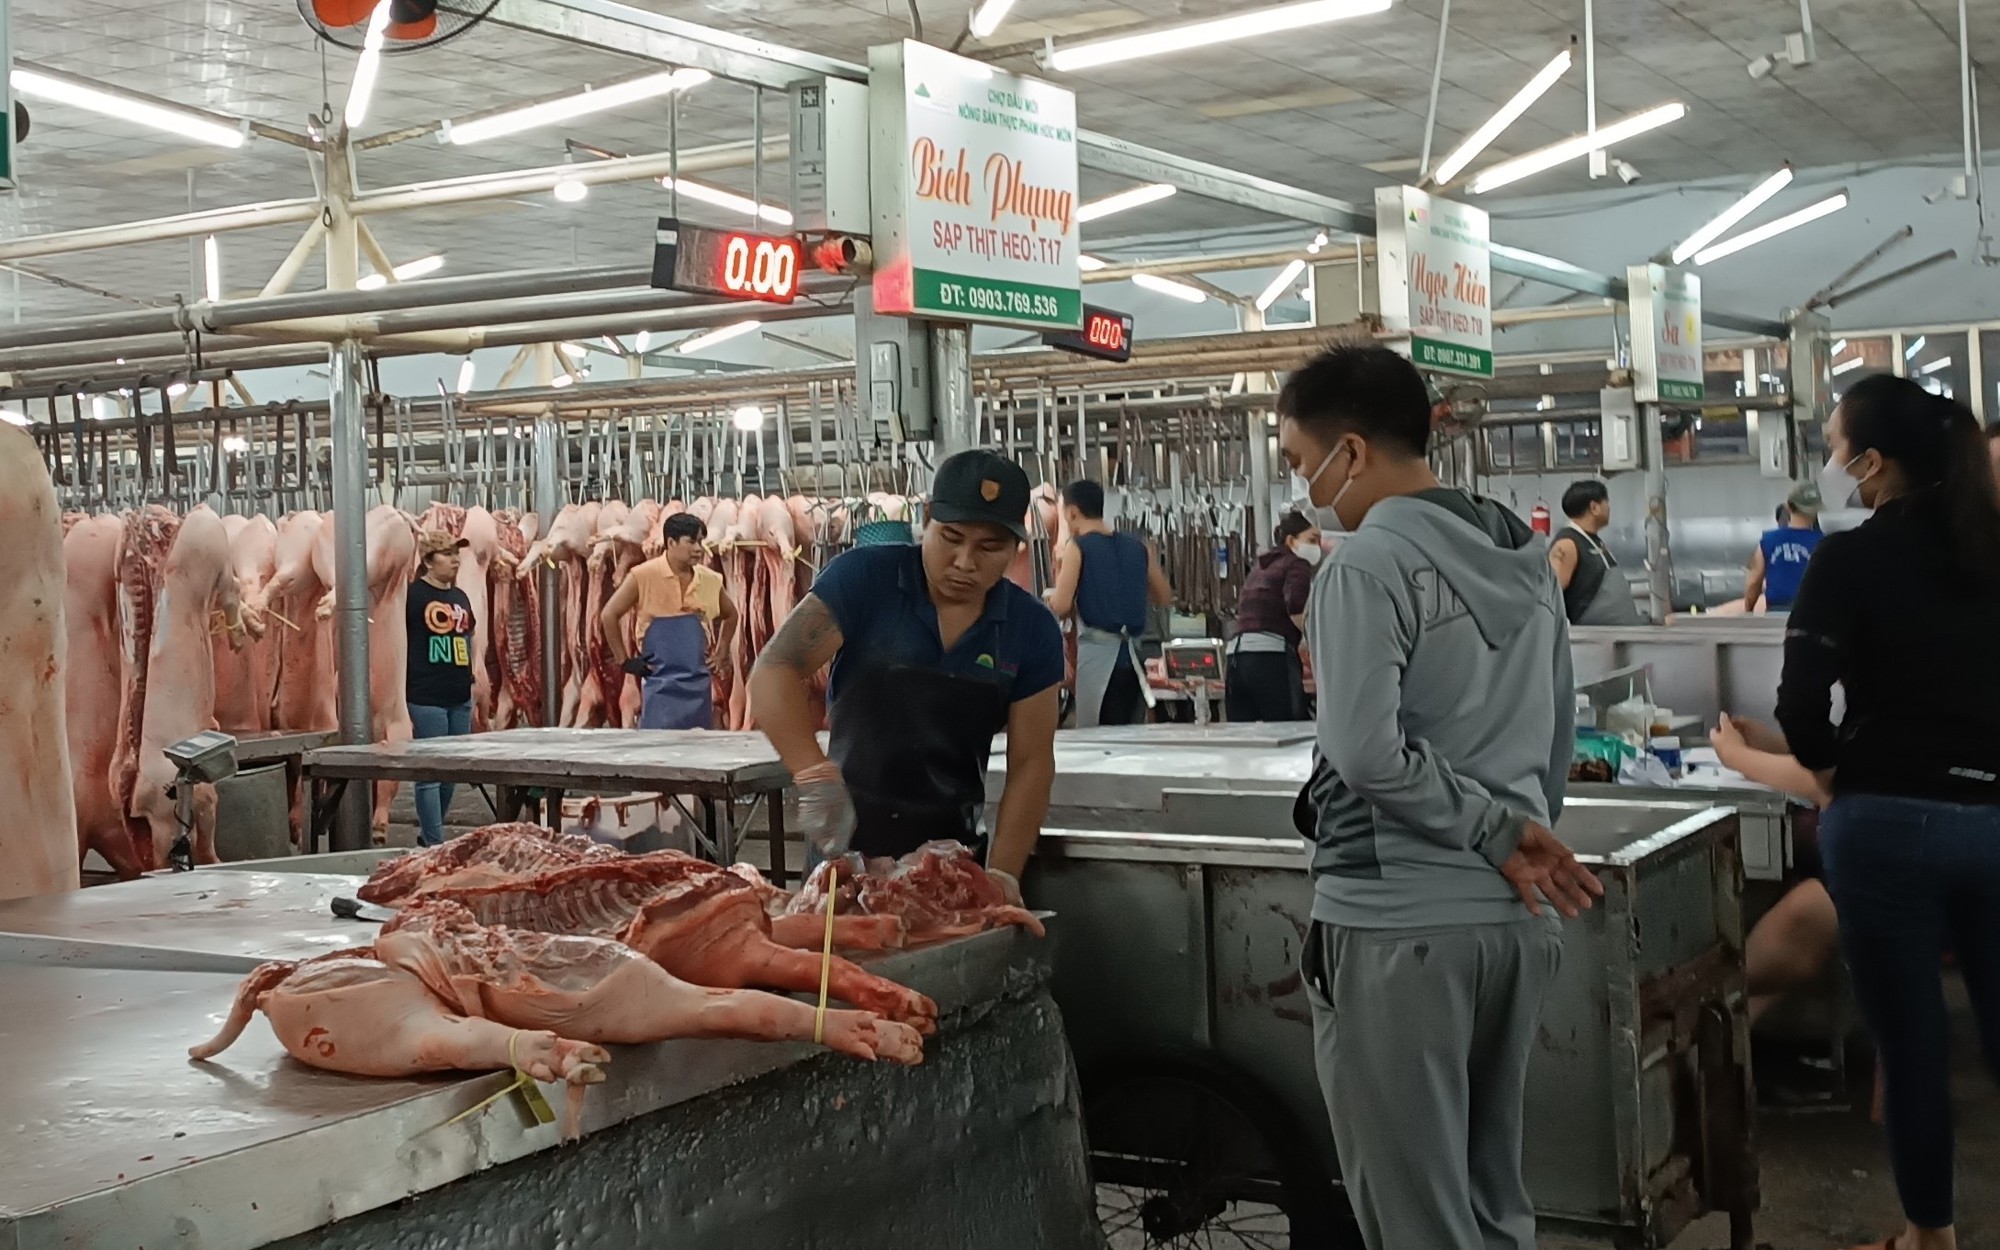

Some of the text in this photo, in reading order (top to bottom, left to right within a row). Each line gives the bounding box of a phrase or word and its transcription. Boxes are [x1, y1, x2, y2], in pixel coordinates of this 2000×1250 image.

[983, 152, 1072, 235] Phụng
[933, 220, 962, 256] SẠP
[966, 225, 997, 261] THỊT
[724, 236, 795, 296] 0.00
[940, 283, 1058, 317] ĐT: 0903.769.536
